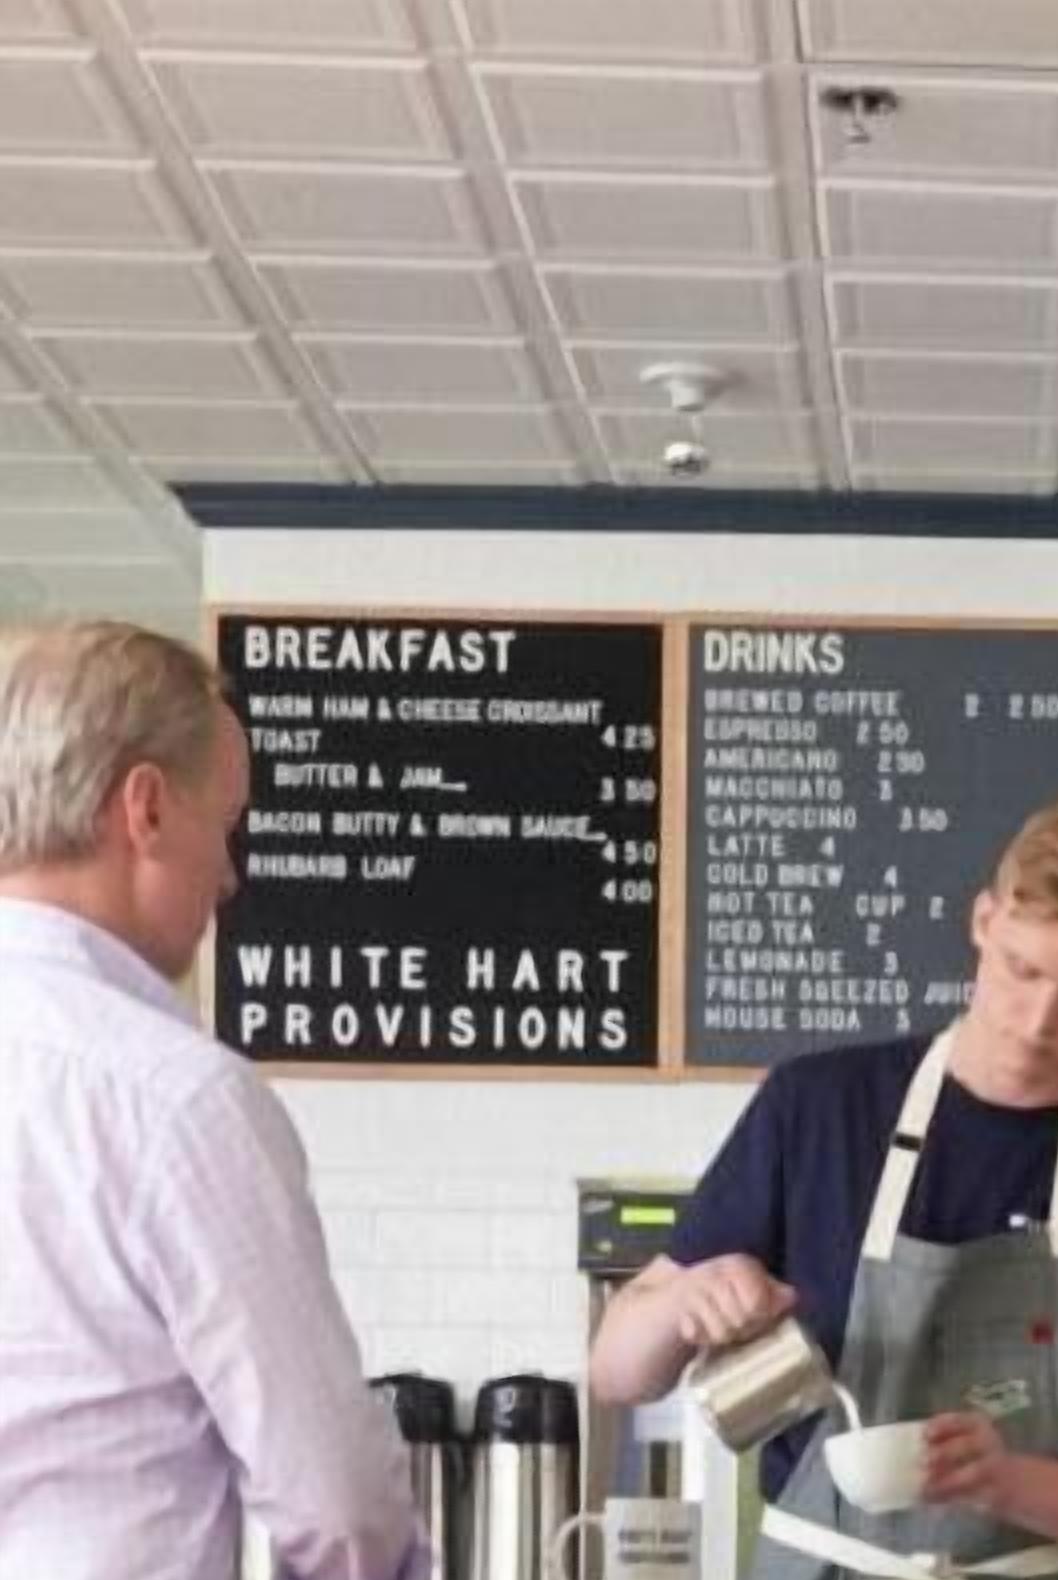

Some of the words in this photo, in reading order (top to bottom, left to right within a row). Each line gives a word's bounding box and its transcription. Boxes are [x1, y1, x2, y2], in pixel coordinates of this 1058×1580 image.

[244, 626, 516, 673] BREAKFAST
[704, 630, 845, 674] DRINKS
[248, 694, 313, 718] WARM
[323, 696, 369, 721] HAM
[398, 698, 481, 722] CHEESE
[704, 688, 803, 713] BREWED
[814, 690, 900, 716] COFFEE
[251, 729, 321, 752] TOAST
[704, 716, 817, 741] ESPRESSO
[704, 748, 838, 772] AMERICANO
[274, 763, 358, 788] BUTTER
[705, 775, 843, 800] MACCHIATO
[248, 811, 320, 834] BACON
[332, 812, 399, 837] BUTTY
[438, 814, 511, 838] BROWN
[705, 805, 857, 831] CAPPUCCINO
[707, 834, 785, 858] LATTE
[820, 835, 835, 858] 4
[248, 853, 347, 878] RHUBARB
[361, 856, 415, 880] LOAF
[707, 863, 768, 887] COLD
[778, 864, 844, 888] BREW
[707, 891, 755, 915] HOT
[768, 893, 814, 917] TEA
[855, 894, 905, 919] CUP
[708, 919, 763, 943] ICED
[772, 921, 815, 945] TEA
[238, 945, 428, 990] WHITE
[467, 947, 629, 992] HART
[706, 950, 844, 974] LEMONADE
[705, 977, 785, 1001] FRESH
[241, 1003, 627, 1049] PROVISIONS
[799, 1007, 861, 1031] SODA
